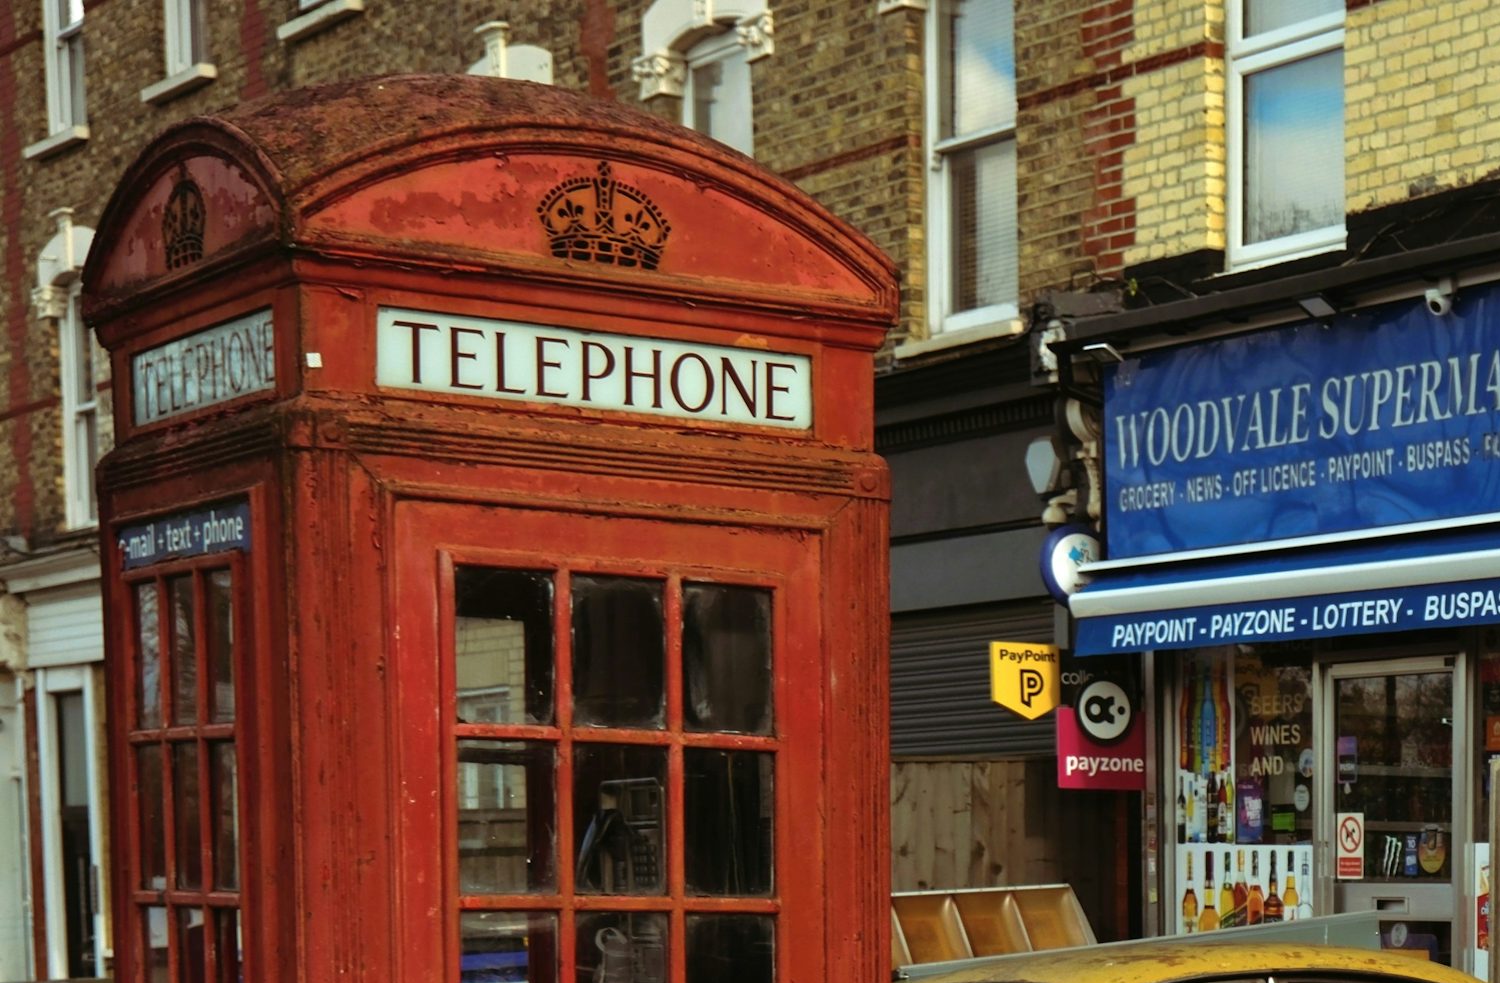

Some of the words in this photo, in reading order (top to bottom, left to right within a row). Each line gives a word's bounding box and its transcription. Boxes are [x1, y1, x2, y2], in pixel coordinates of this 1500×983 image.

[139, 319, 277, 420] TELEPHONE
[391, 319, 798, 422] TELEPHONE
[1115, 383, 1311, 470] WOODVALE
[1119, 481, 1176, 513] GROCERY
[1186, 474, 1223, 503] NEWS
[1232, 469, 1257, 497] OFF
[1260, 460, 1317, 493] LICENCE
[1328, 447, 1395, 485] PAYPOINT
[1406, 437, 1471, 473] BUSPASS
[166, 519, 193, 552] text
[202, 510, 244, 553] phone
[1111, 616, 1197, 648] PAYPOINT
[1210, 608, 1296, 640] PAYZONE
[1312, 598, 1404, 631] LOTTERY
[1000, 648, 1057, 664] PayPoint
[1250, 724, 1301, 746] WINES
[1065, 754, 1144, 777] payzone
[1250, 755, 1284, 777] AND
